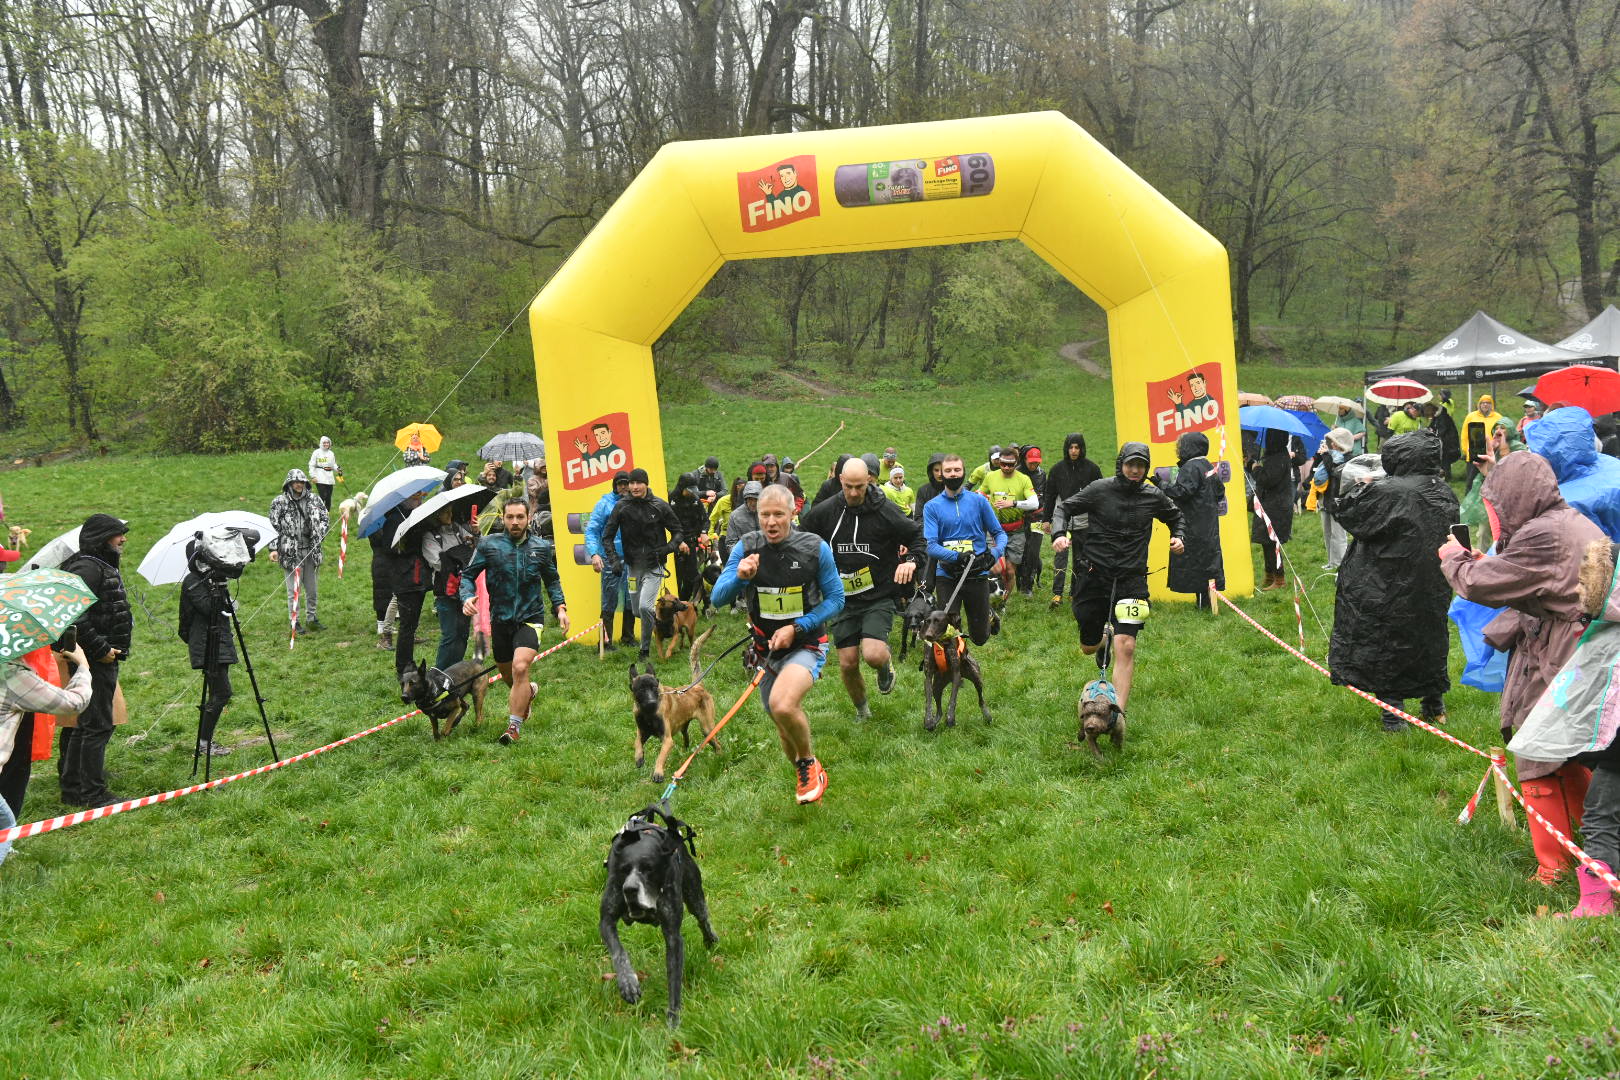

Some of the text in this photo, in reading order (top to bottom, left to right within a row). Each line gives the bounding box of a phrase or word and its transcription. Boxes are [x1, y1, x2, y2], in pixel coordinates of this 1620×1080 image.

[937, 165, 958, 176] FINO
[968, 156, 989, 193] 60L
[747, 190, 812, 227] FINO
[1156, 399, 1219, 437] FINO
[566, 449, 627, 484] FINO
[849, 577, 863, 590] 18
[776, 597, 783, 611] 1
[1126, 605, 1139, 617] 13
